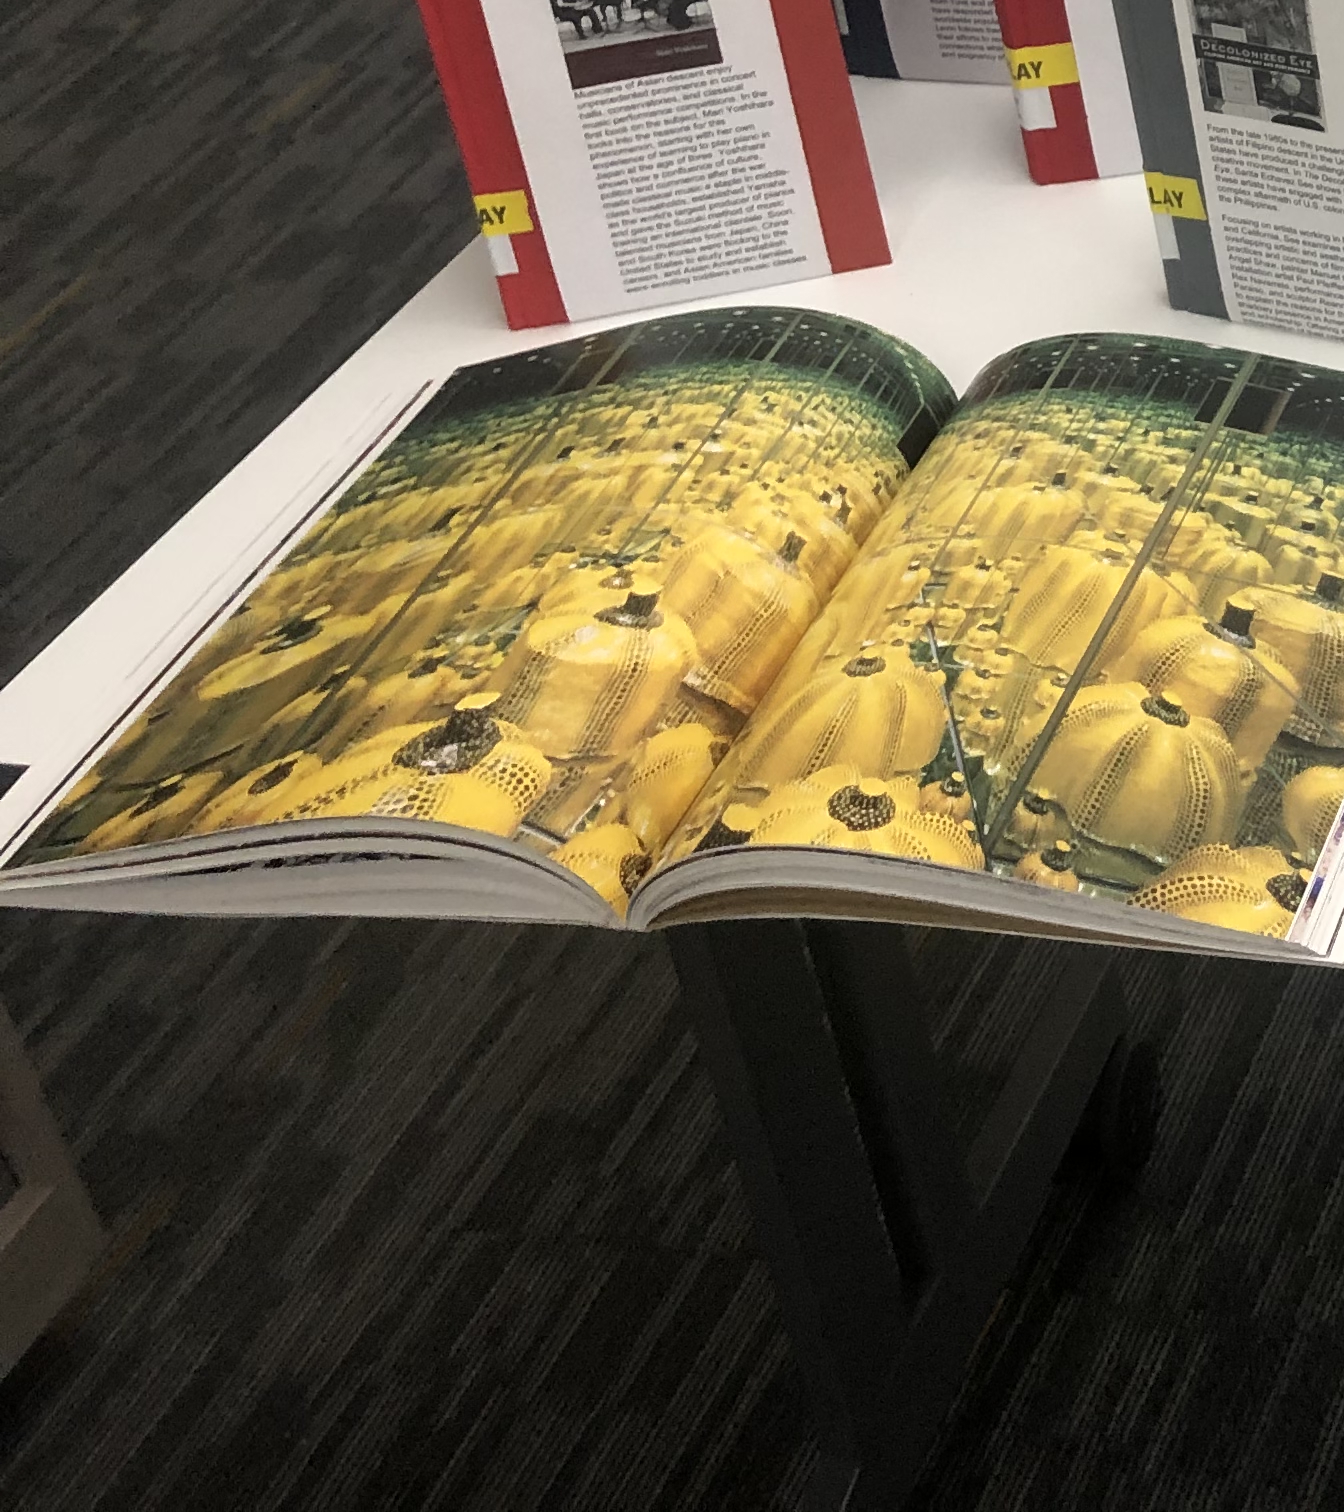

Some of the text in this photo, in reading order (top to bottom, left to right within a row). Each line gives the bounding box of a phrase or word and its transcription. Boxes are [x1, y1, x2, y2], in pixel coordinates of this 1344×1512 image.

[1206, 123, 1230, 135] From
[1231, 127, 1244, 138] the
[1246, 129, 1262, 140] late
[1290, 138, 1299, 147] to
[1300, 140, 1313, 150] the
